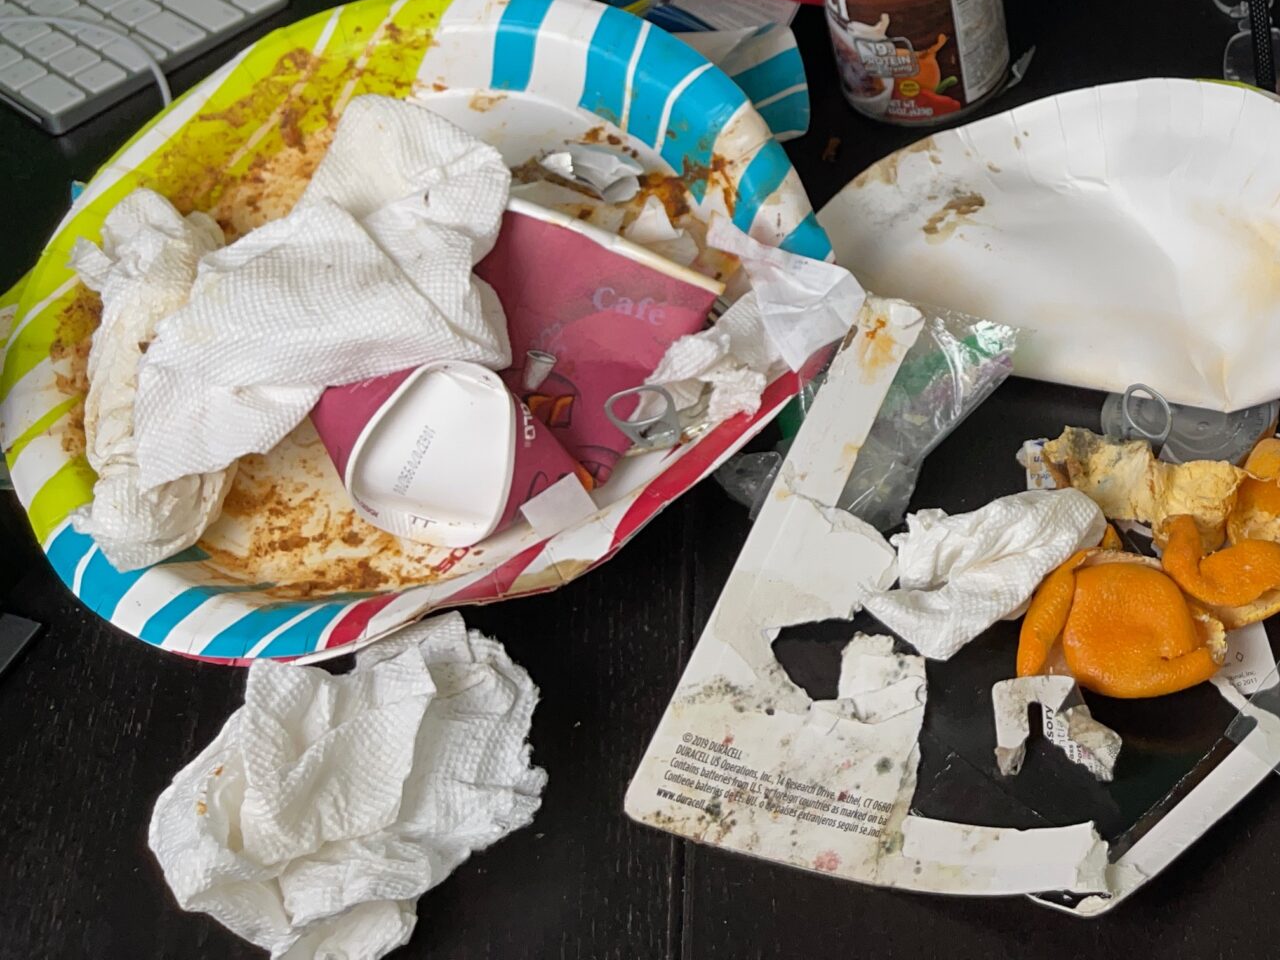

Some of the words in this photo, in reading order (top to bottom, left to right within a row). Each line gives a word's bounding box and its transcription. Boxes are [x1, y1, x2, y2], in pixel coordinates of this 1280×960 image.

[675, 743, 710, 763] DURACELL
[710, 755, 720, 766] US
[719, 758, 759, 779] Operations,
[785, 776, 815, 794] Research
[863, 797, 872, 808] CT
[691, 735, 708, 748] 2019
[707, 740, 743, 759] DURACELL
[663, 769, 694, 788] Contiene
[723, 788, 733, 799] de
[797, 808, 837, 828] extranjeros
[669, 757, 700, 775] Contains
[699, 766, 731, 784] batteries
[731, 776, 749, 790] from
[772, 788, 798, 805] foreign
[798, 794, 831, 812] countries
[830, 804, 840, 814] as
[839, 805, 867, 821] marked
[867, 813, 876, 823] on
